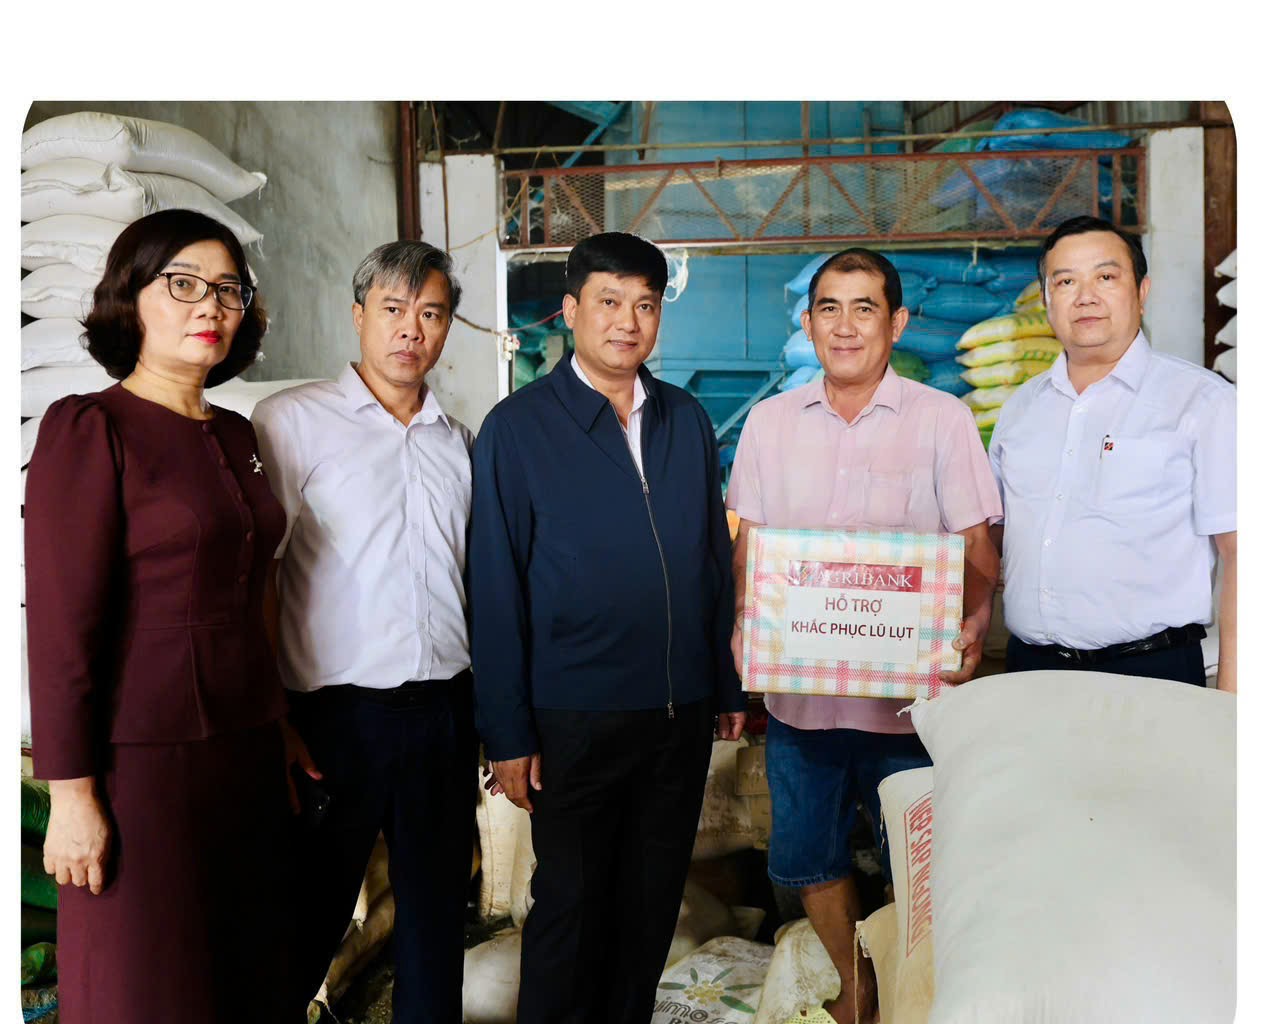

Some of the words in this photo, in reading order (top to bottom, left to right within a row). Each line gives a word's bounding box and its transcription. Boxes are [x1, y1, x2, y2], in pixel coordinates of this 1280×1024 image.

[818, 571, 913, 588] AGRIBANK
[825, 593, 848, 612] HỖ
[851, 598, 883, 617] TRỢ
[792, 618, 827, 634] KHẮC
[830, 623, 867, 639] PHỤC
[870, 623, 886, 638] LŨ
[890, 627, 914, 642] LỤT
